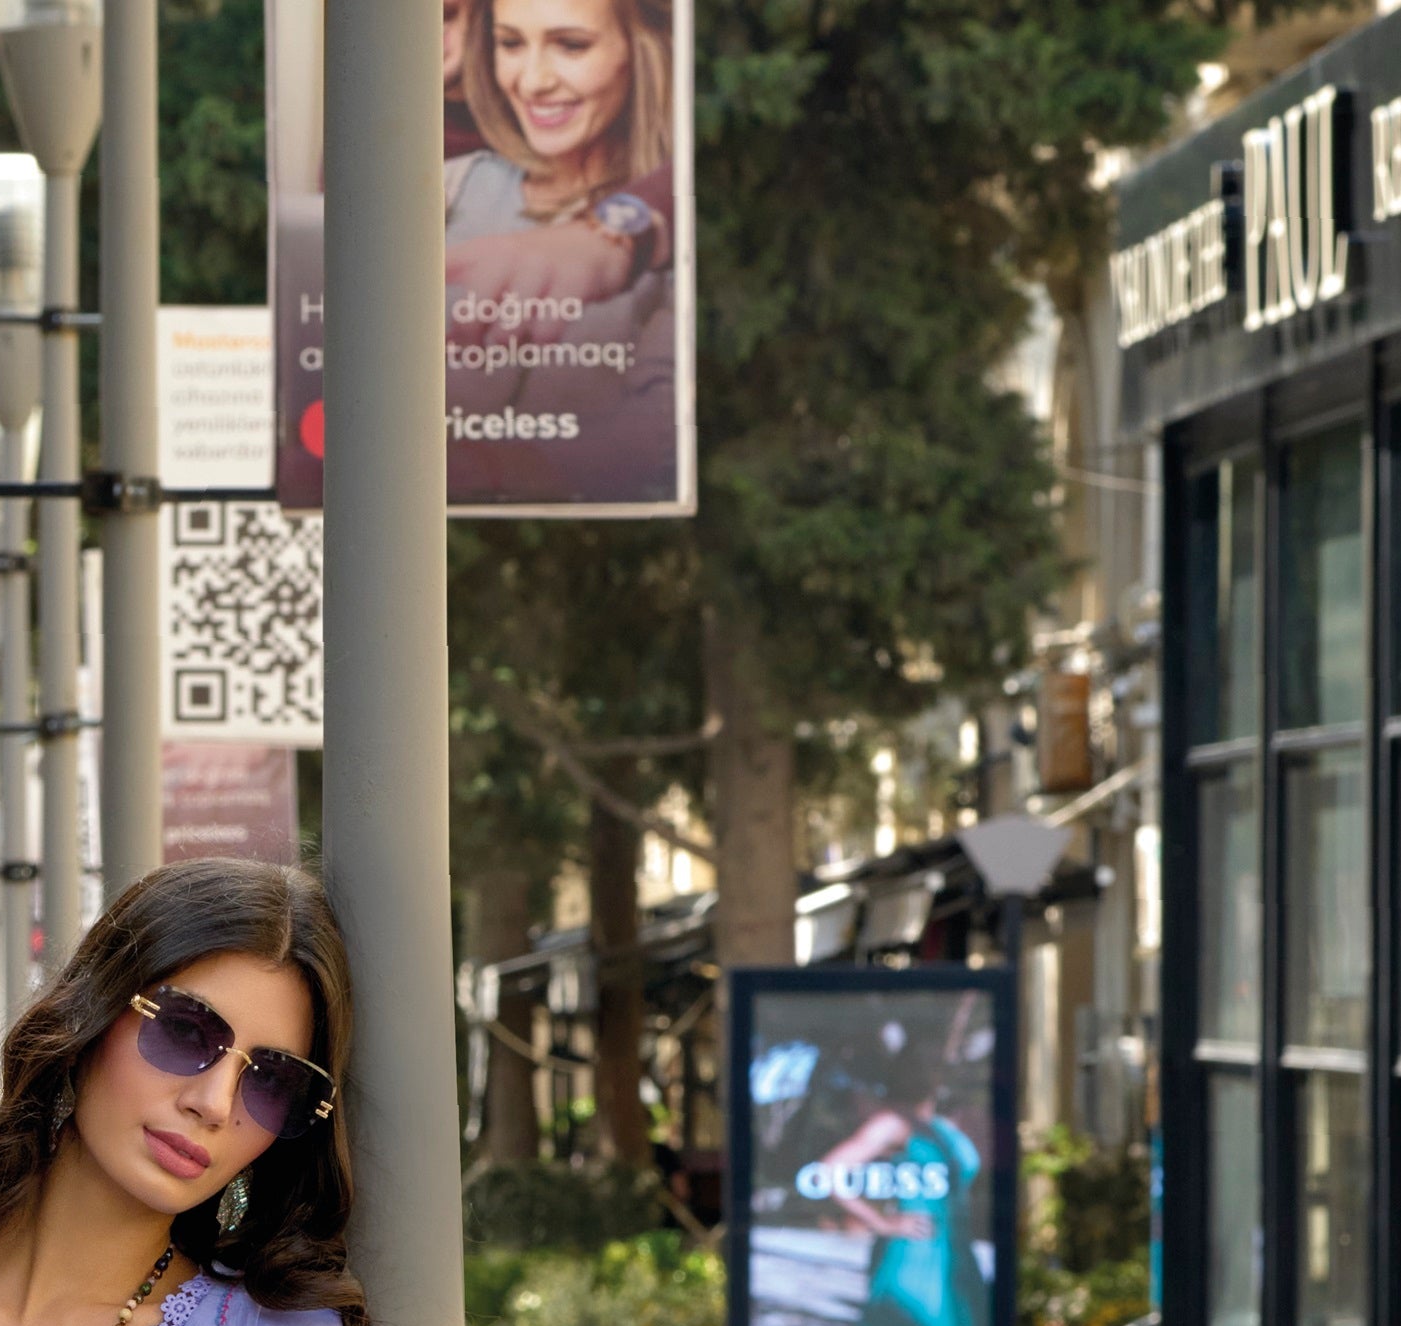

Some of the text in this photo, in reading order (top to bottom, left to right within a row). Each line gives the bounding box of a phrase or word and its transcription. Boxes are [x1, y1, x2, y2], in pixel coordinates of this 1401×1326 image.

[1242, 84, 1350, 333] PAUL
[451, 292, 584, 330] doğma
[445, 406, 580, 440] iceless
[795, 1161, 949, 1200] GUESS
